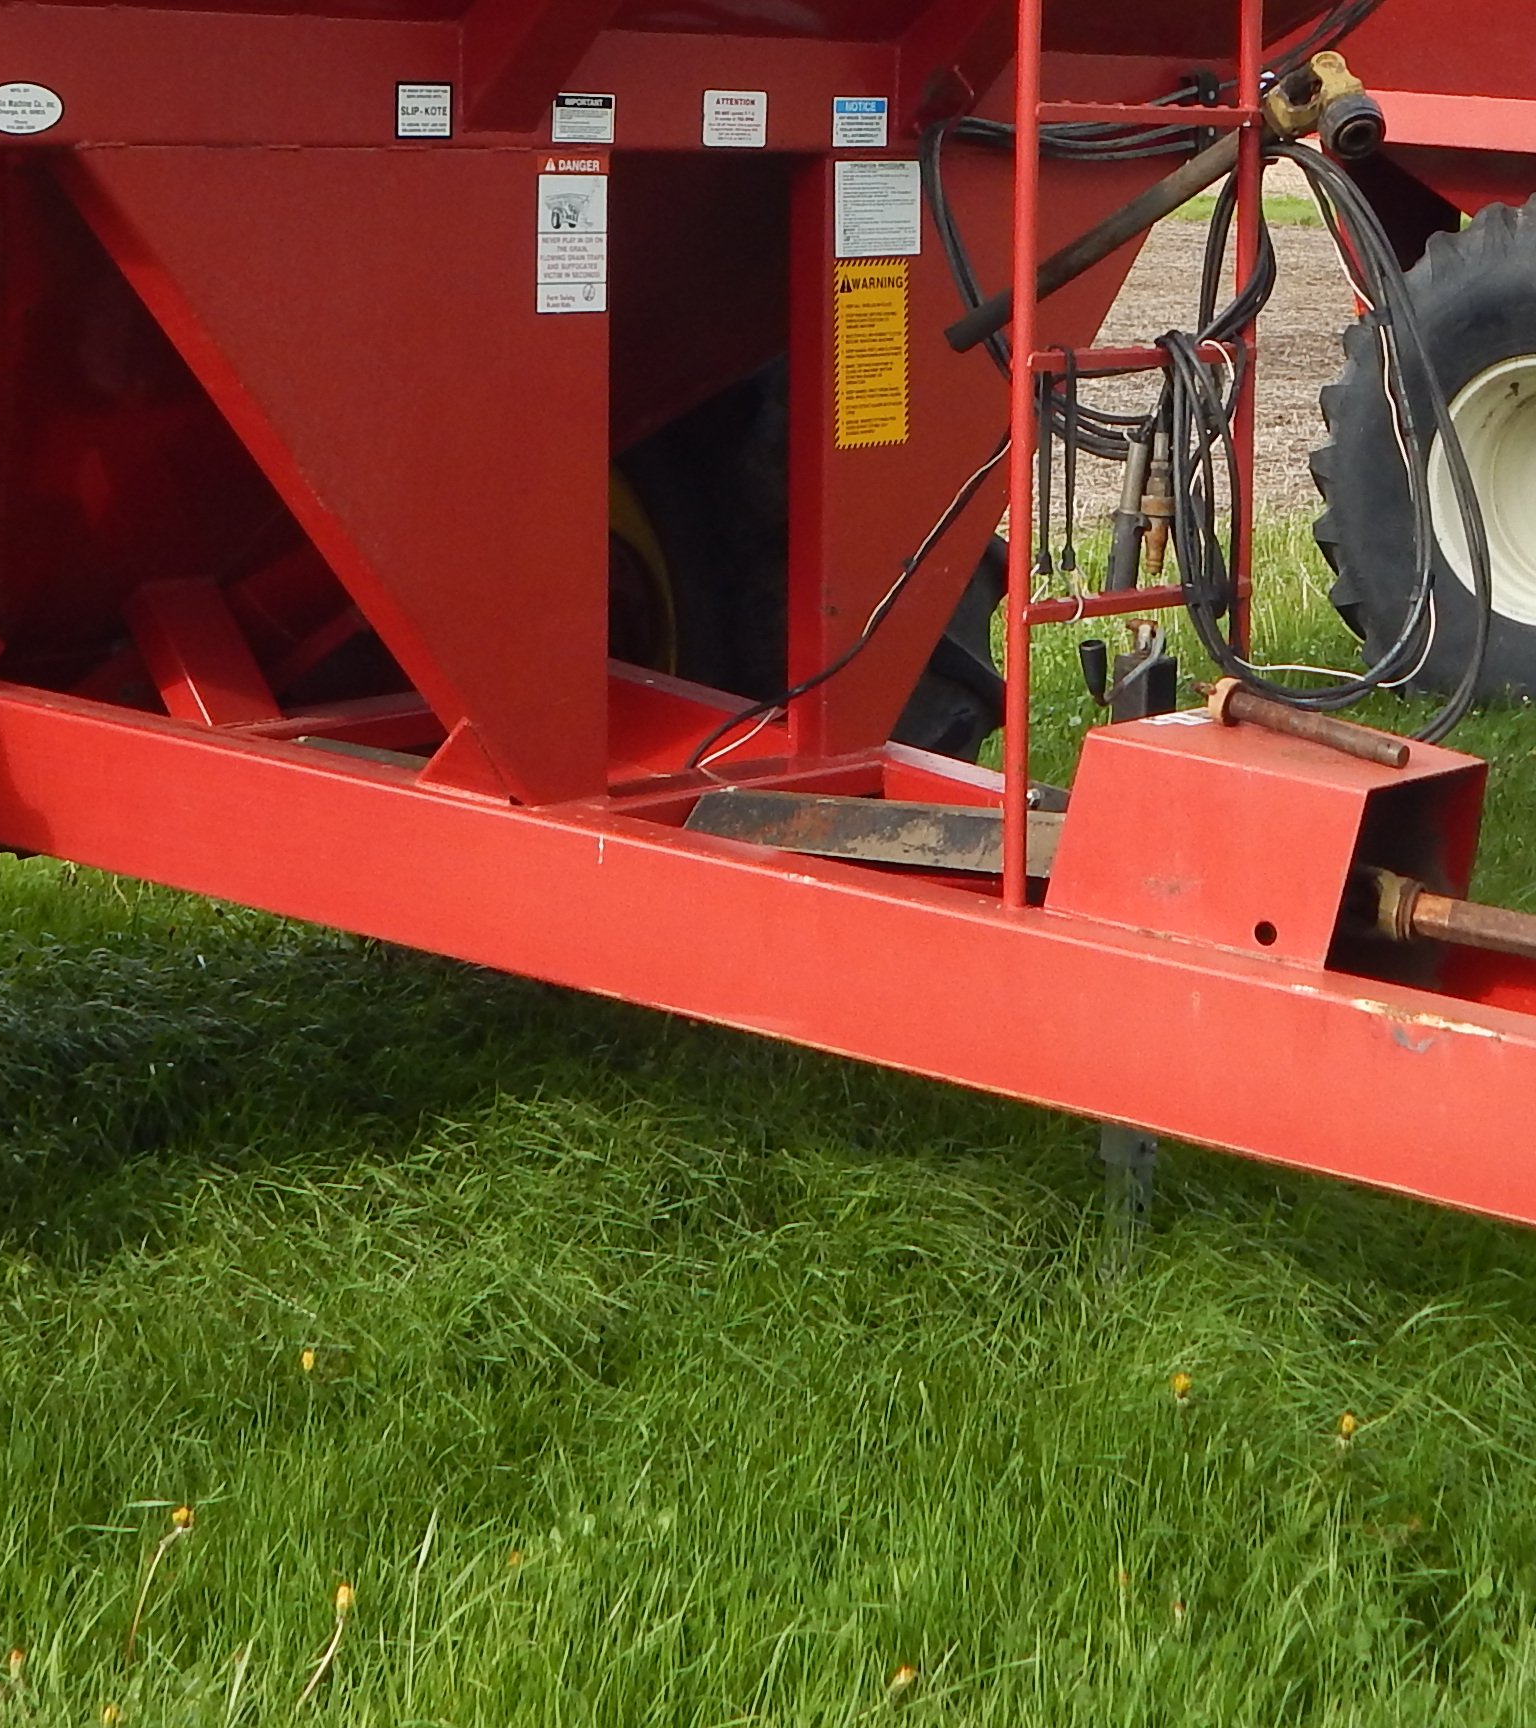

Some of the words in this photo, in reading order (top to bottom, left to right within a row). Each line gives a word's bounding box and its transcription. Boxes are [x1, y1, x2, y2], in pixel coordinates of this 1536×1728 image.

[715, 97, 756, 106] ATTENTION
[845, 101, 877, 112] NOTICE
[558, 159, 600, 172] DANGER
[851, 275, 904, 290] WARNING
